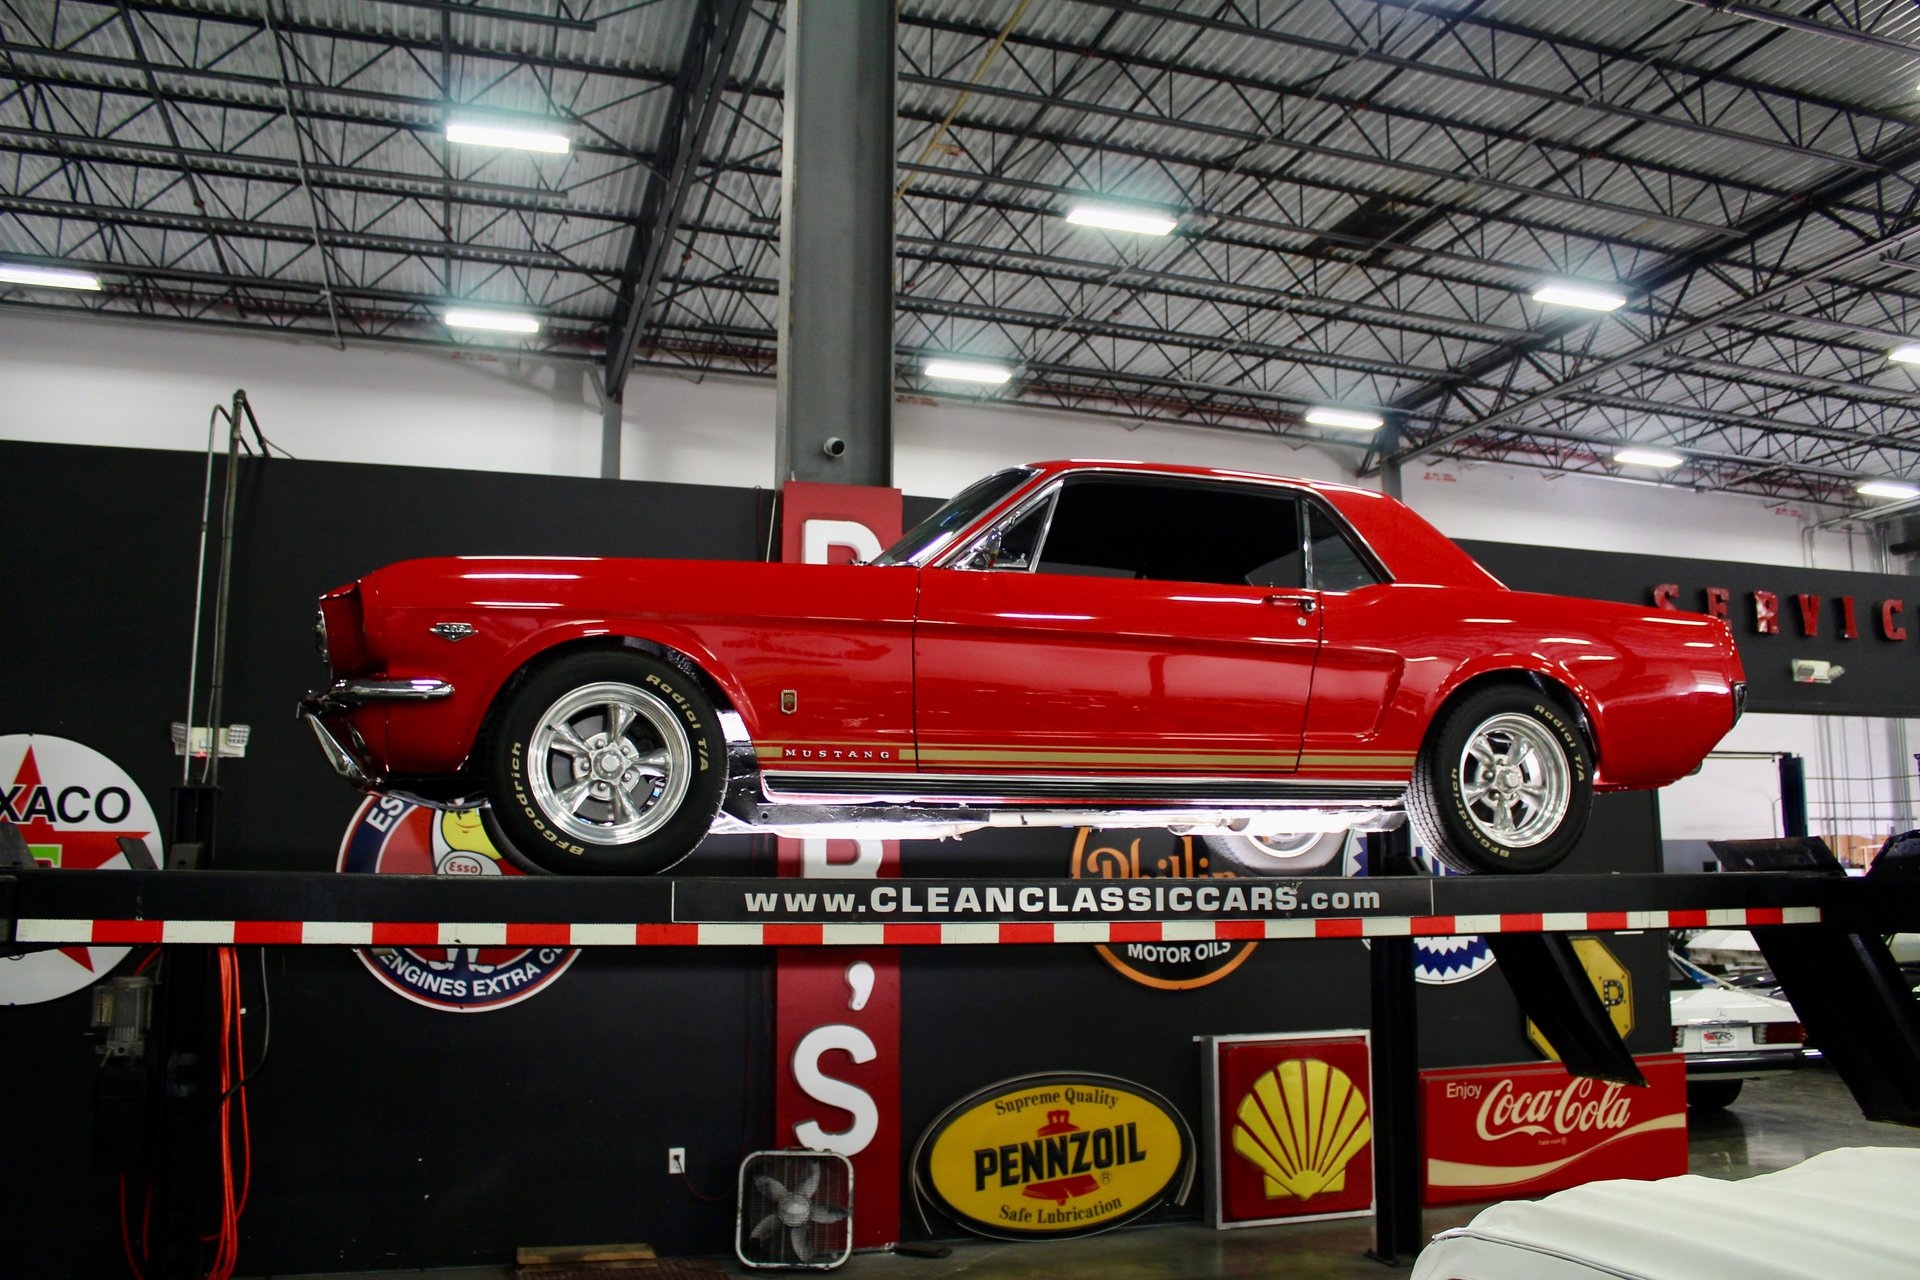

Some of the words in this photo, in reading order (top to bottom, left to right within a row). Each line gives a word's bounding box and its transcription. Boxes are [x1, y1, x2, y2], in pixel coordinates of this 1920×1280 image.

[645, 674, 702, 729] Radial
[697, 737, 709, 771] T/A
[1534, 704, 1577, 748] Radial
[1574, 754, 1585, 782] T/A
[785, 749, 890, 759] MUSTANG
[511, 742, 585, 855] BFGoodrich
[1451, 768, 1510, 858] BFGoodrich
[744, 886, 1381, 913] www.CLEANCLASSICCARS.com
[380, 948, 467, 997] ENGINES
[472, 963, 542, 997] EXTRA
[1127, 943, 1192, 964] MOTOR
[994, 1091, 1060, 1116] Supreme
[1064, 1087, 1119, 1109] Quality
[1446, 1082, 1483, 1100] Enjoy
[1476, 1076, 1632, 1141] Coca-Cola
[973, 1121, 1147, 1192] PENNZOIL
[998, 1204, 1032, 1222] Safe
[1036, 1197, 1123, 1224] Lubrication
